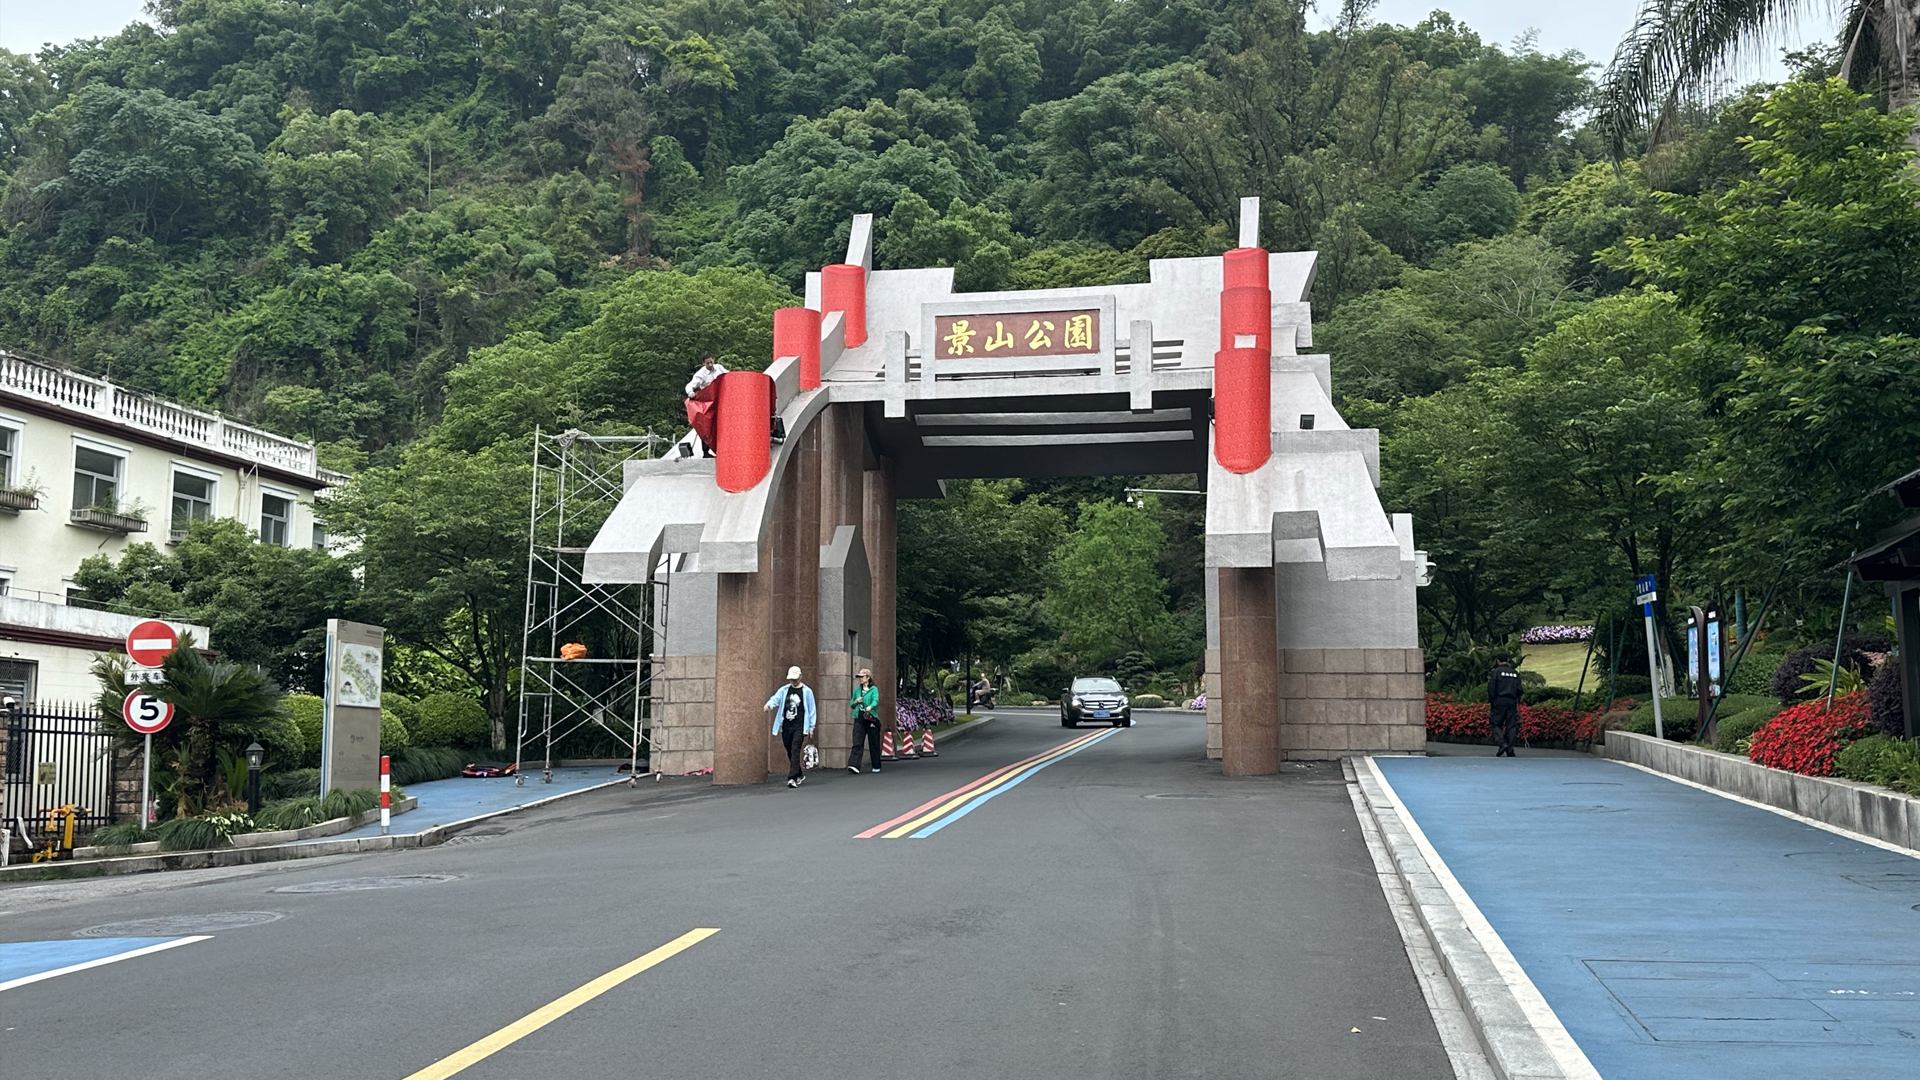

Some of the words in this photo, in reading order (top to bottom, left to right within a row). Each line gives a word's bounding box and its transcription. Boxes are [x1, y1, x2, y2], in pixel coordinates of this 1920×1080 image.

[943, 314, 1093, 356] 景山公園
[140, 698, 159, 720] 5
